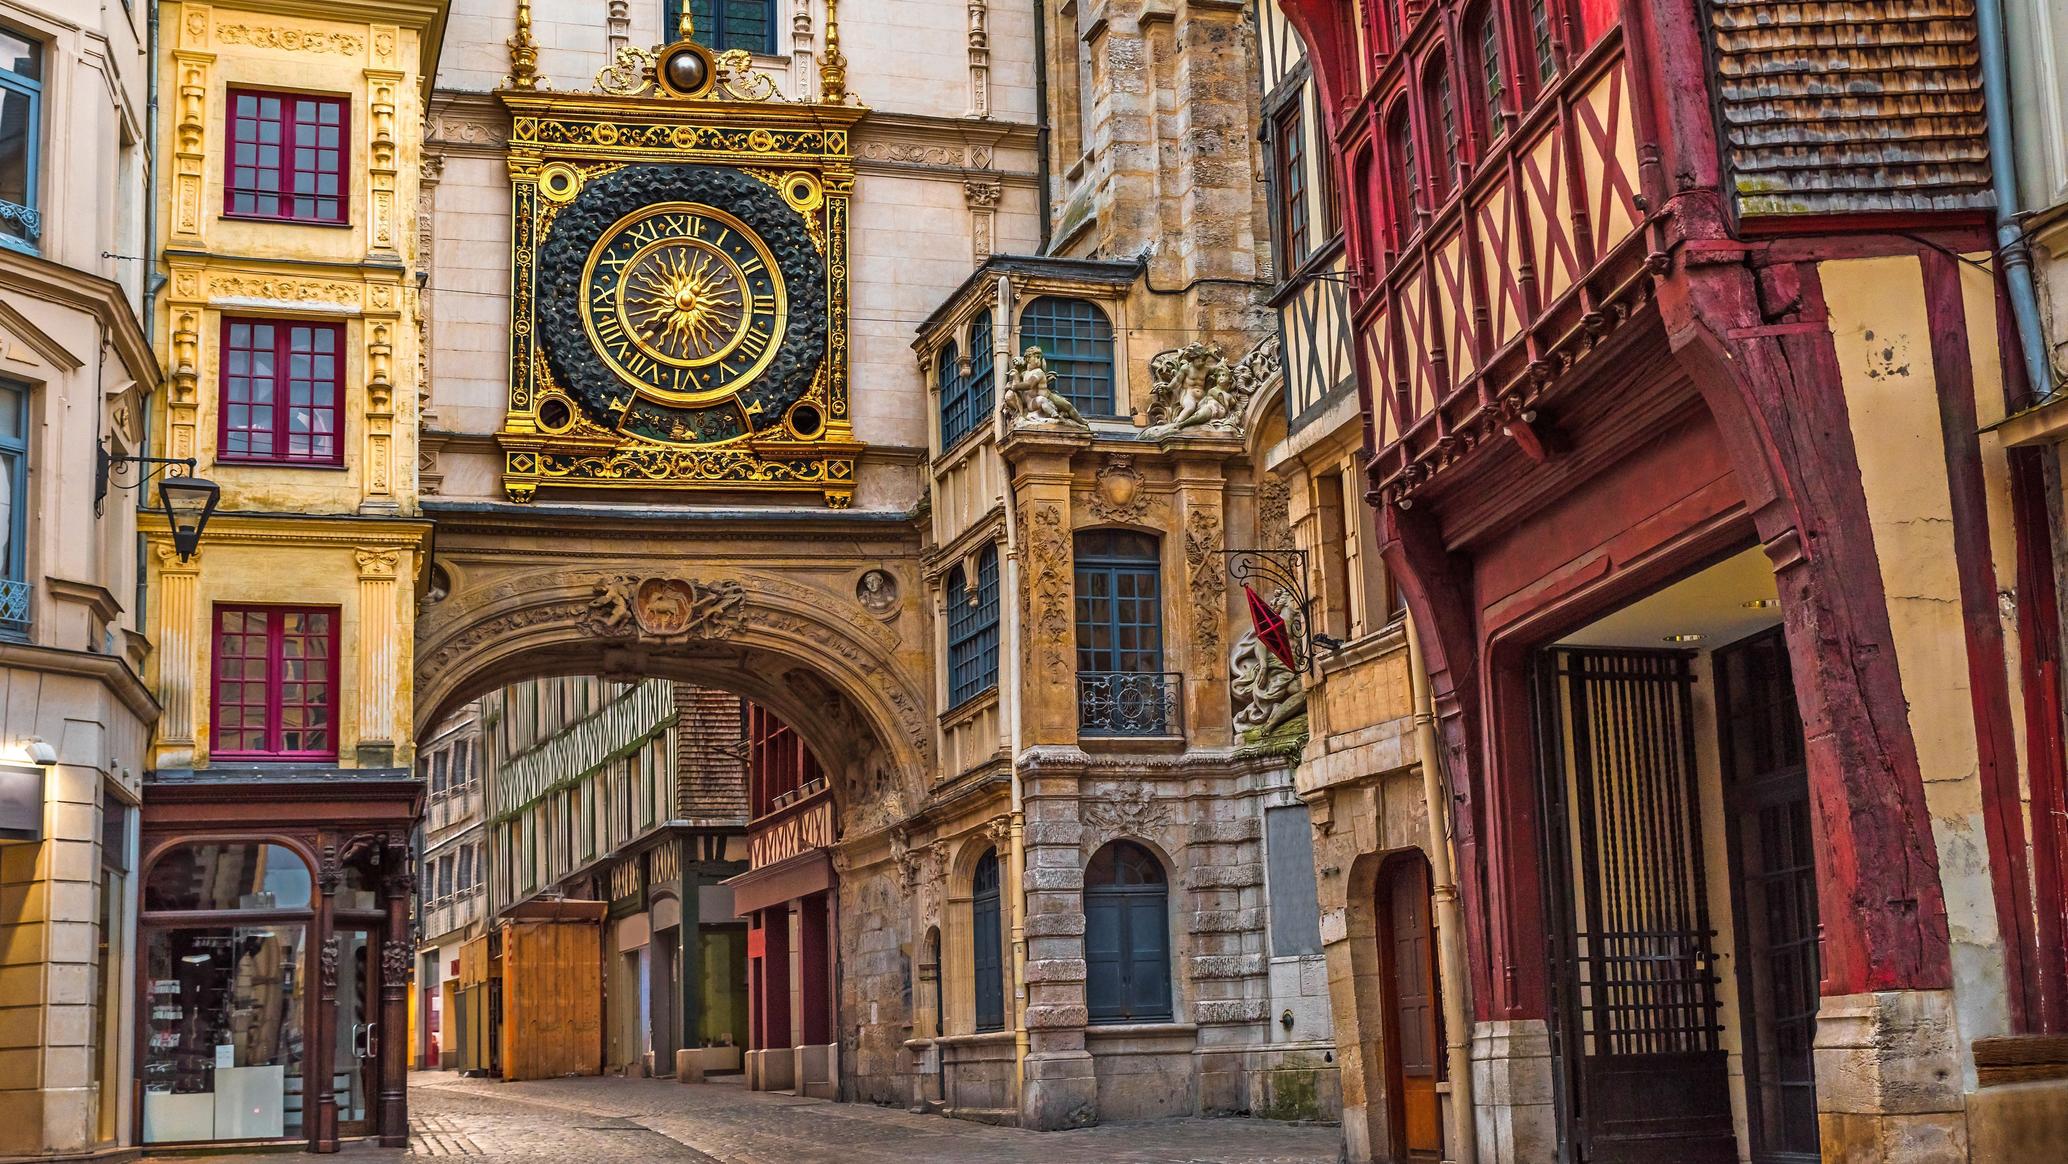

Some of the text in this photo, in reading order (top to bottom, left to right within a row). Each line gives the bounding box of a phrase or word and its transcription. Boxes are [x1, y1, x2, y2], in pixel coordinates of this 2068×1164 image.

[625, 219, 660, 250] XI
[663, 215, 701, 238] XII
[715, 228, 730, 247] I
[600, 248, 630, 275] X
[740, 256, 764, 276] II
[593, 284, 616, 313] IX
[753, 294, 775, 315] III
[596, 317, 630, 362] VIII
[738, 326, 770, 360] IIII
[626, 352, 660, 385] VII
[672, 369, 703, 390] VI
[720, 361, 740, 384] V
